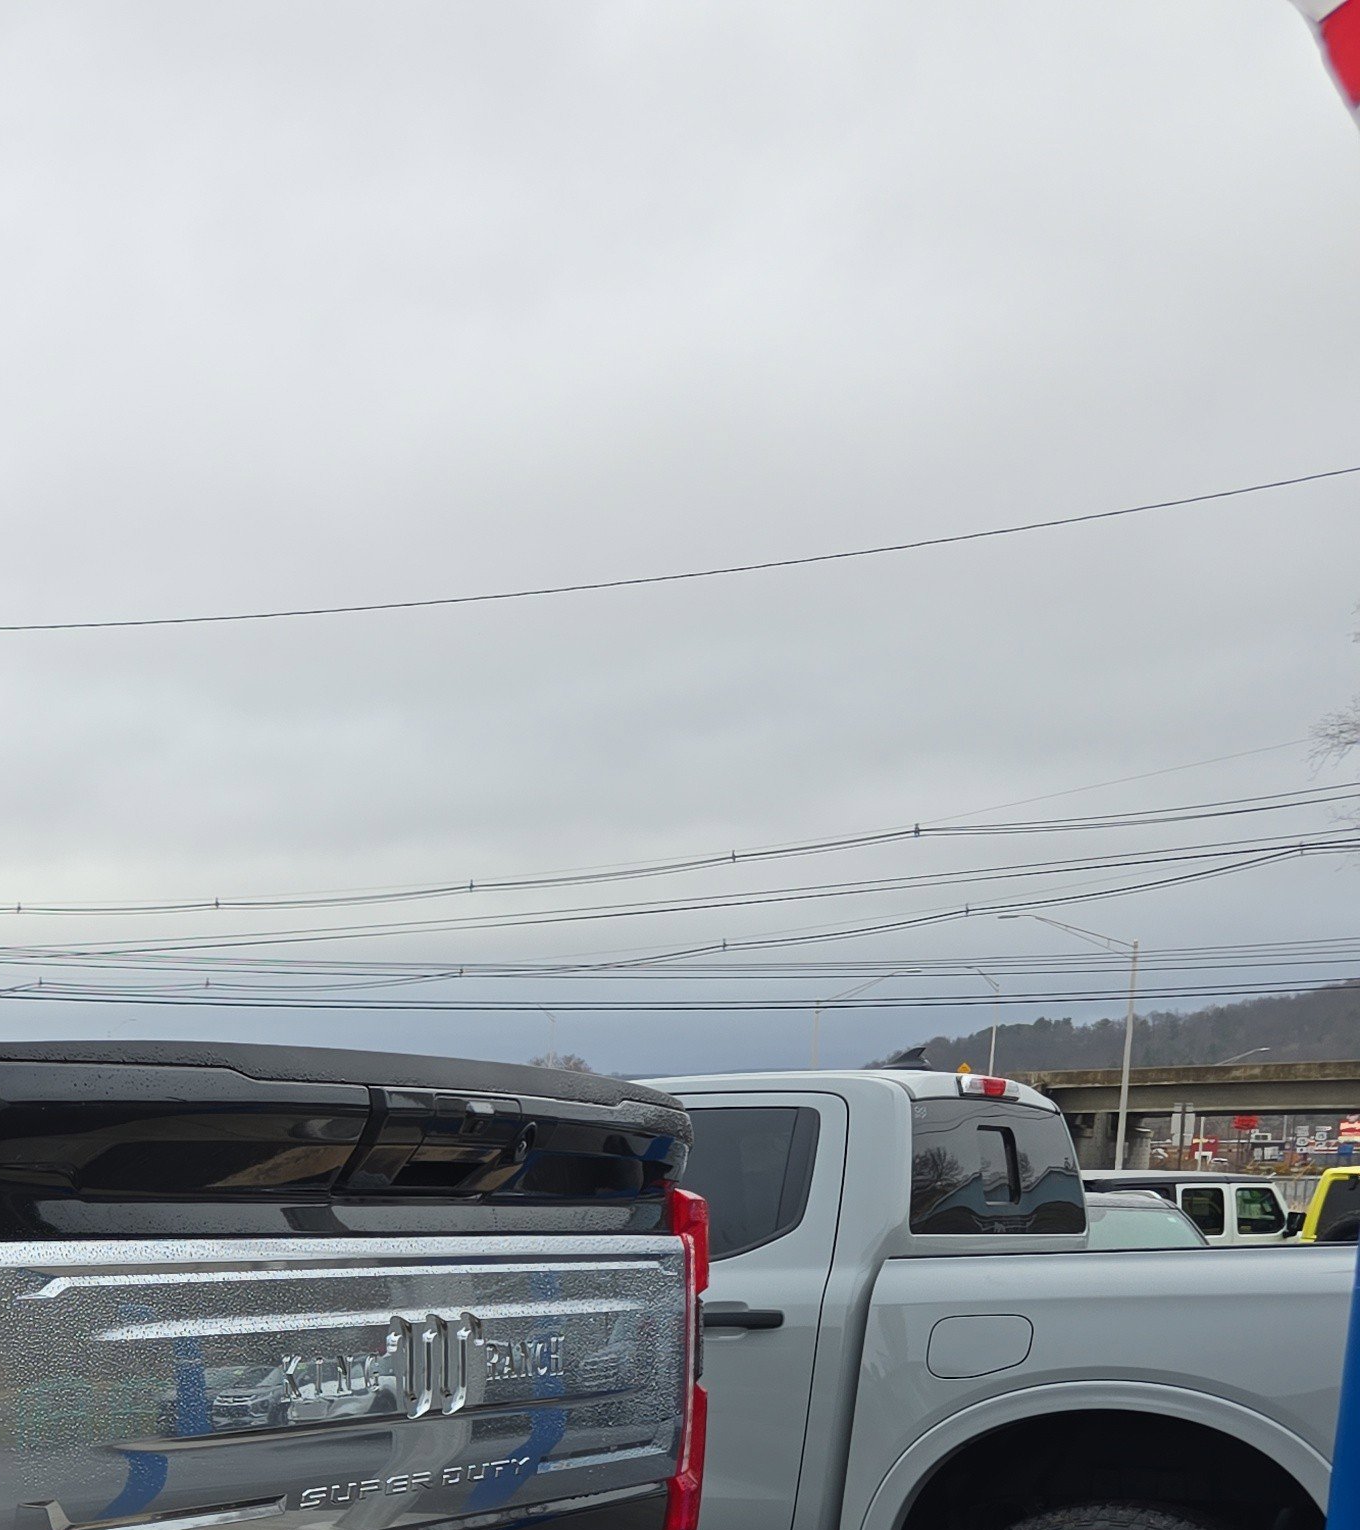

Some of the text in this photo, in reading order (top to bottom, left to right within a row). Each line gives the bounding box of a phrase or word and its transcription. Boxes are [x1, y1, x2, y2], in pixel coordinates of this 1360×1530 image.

[281, 1335, 565, 1402] KING RANCH
[299, 1457, 530, 1511] SUPER DUTY
